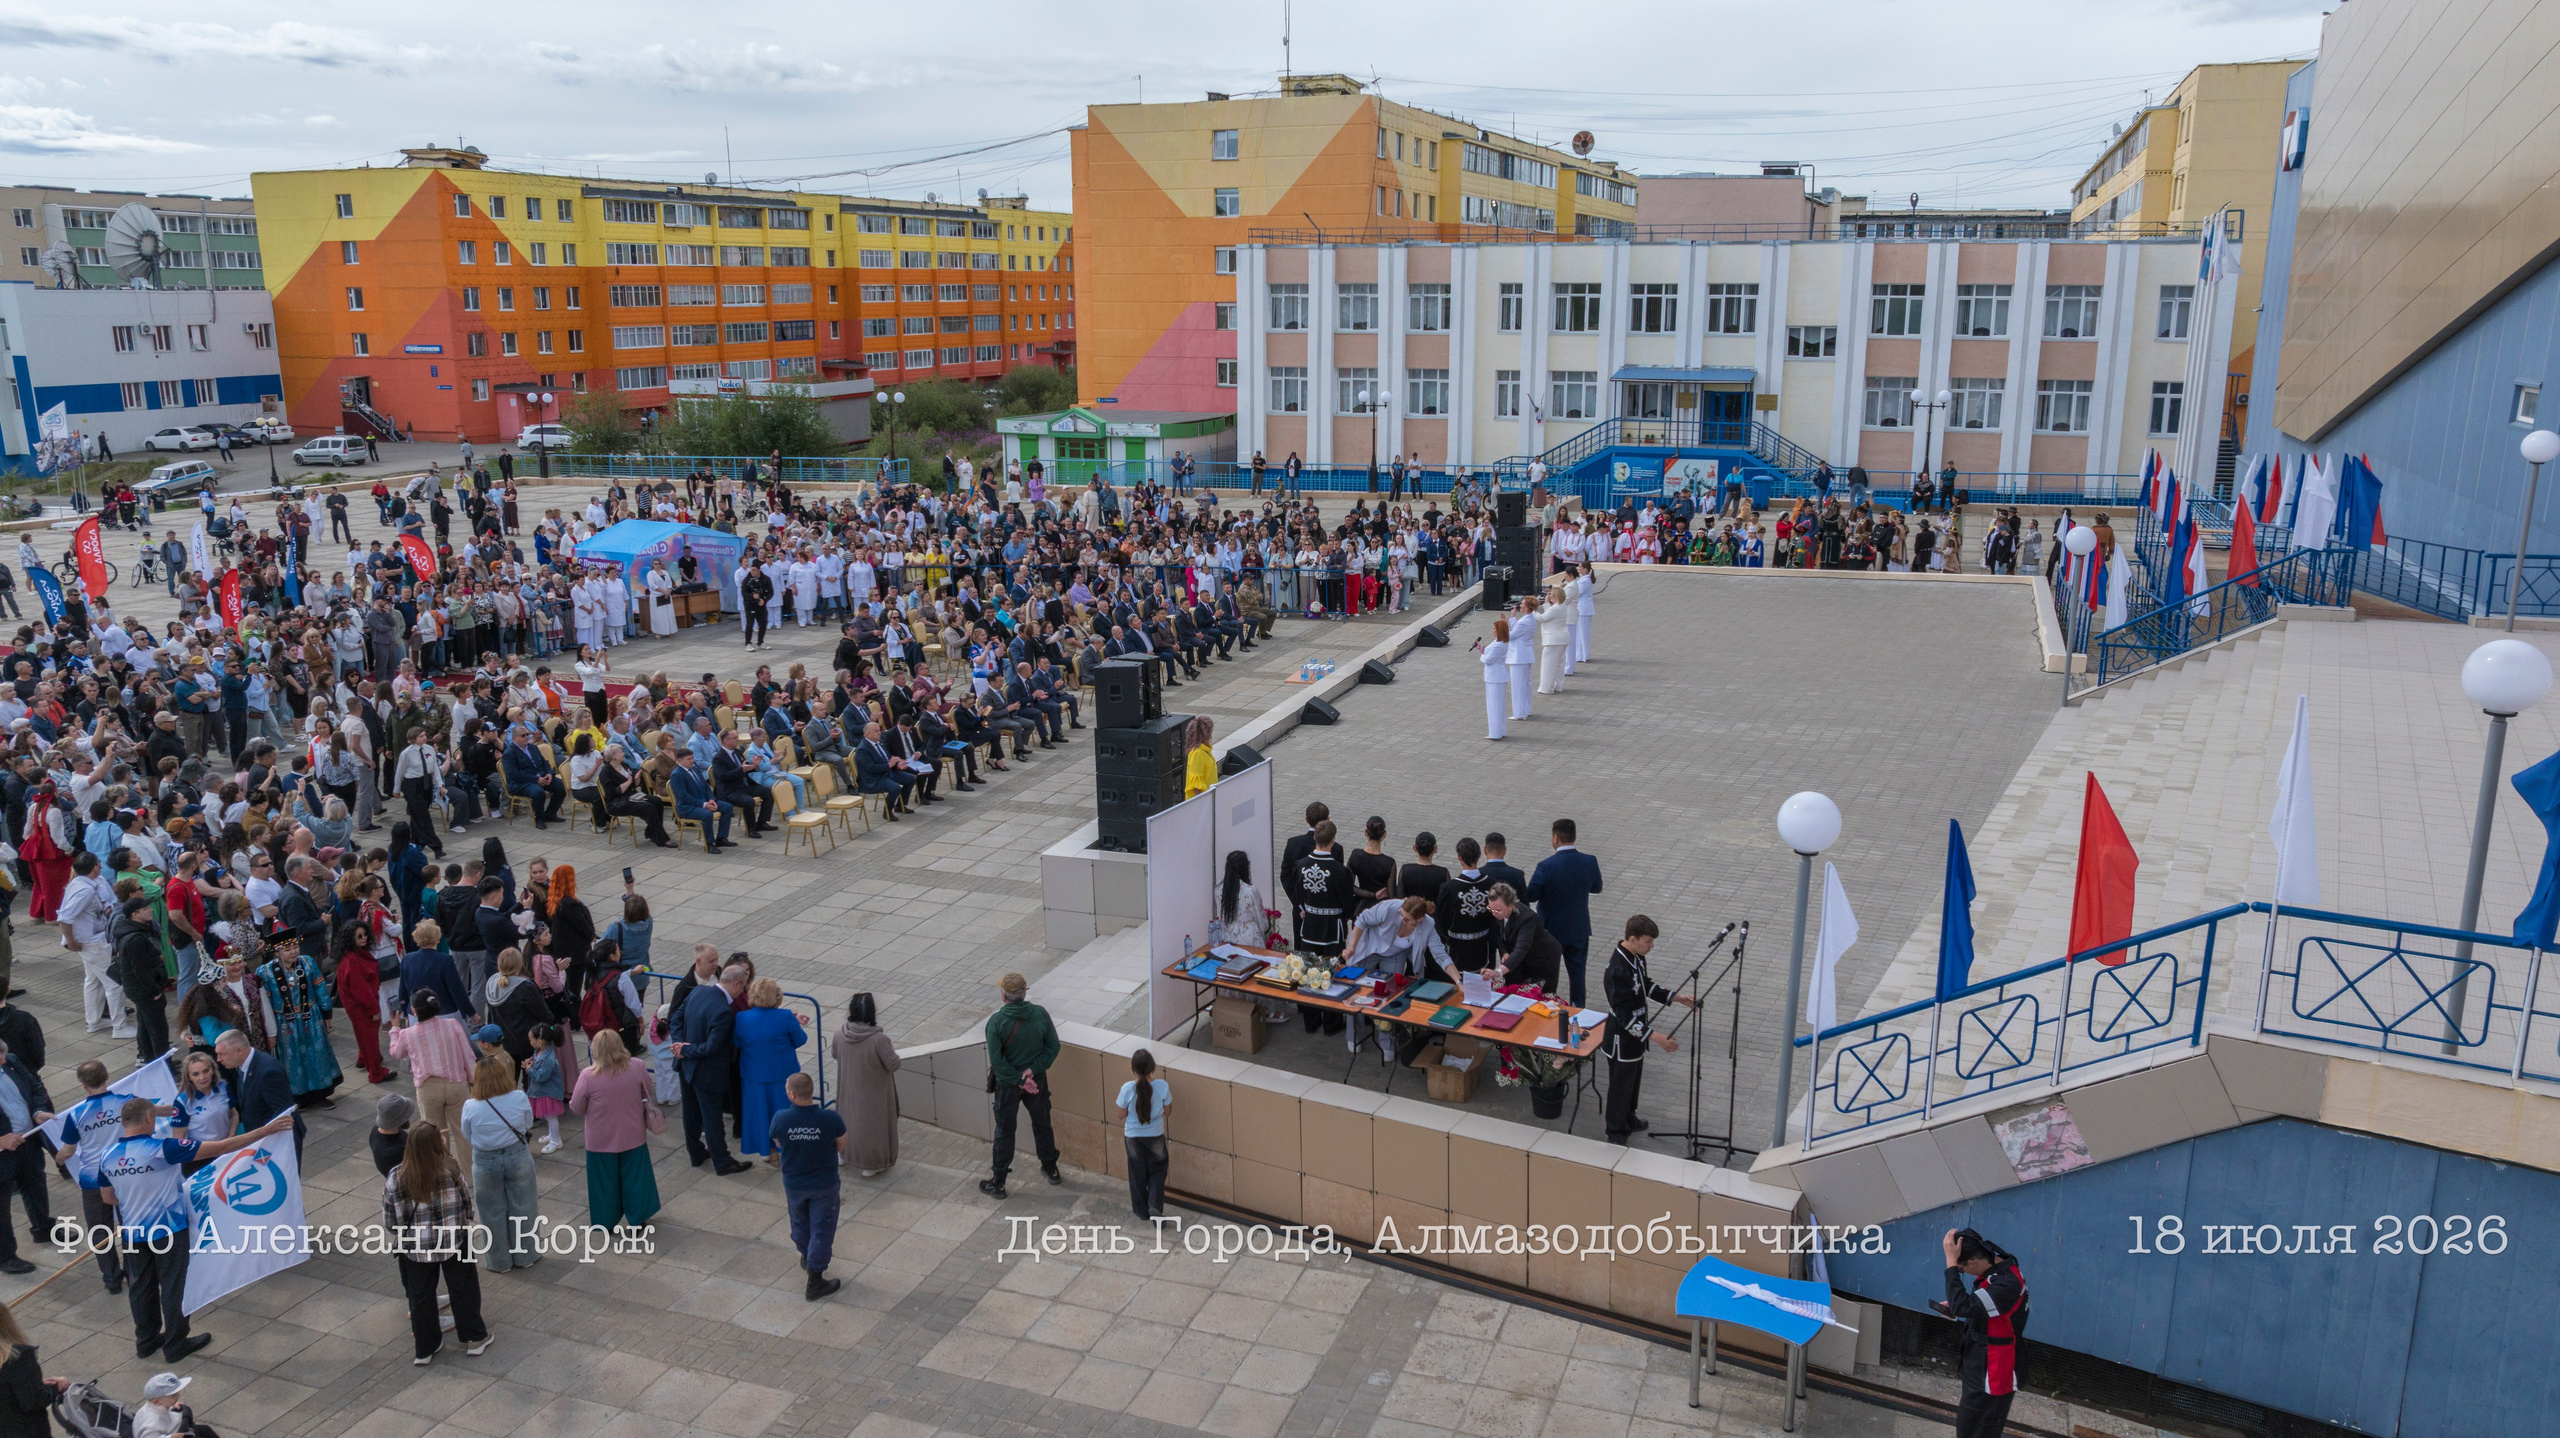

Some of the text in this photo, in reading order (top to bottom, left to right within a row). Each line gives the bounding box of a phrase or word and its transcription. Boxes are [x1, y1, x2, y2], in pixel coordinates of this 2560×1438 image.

[89, 529, 103, 564] АЛРОСА
[85, 1115, 121, 1132] АЛРОС
[107, 1165, 154, 1178] АЛРОСА
[227, 1164, 262, 1206] 14
